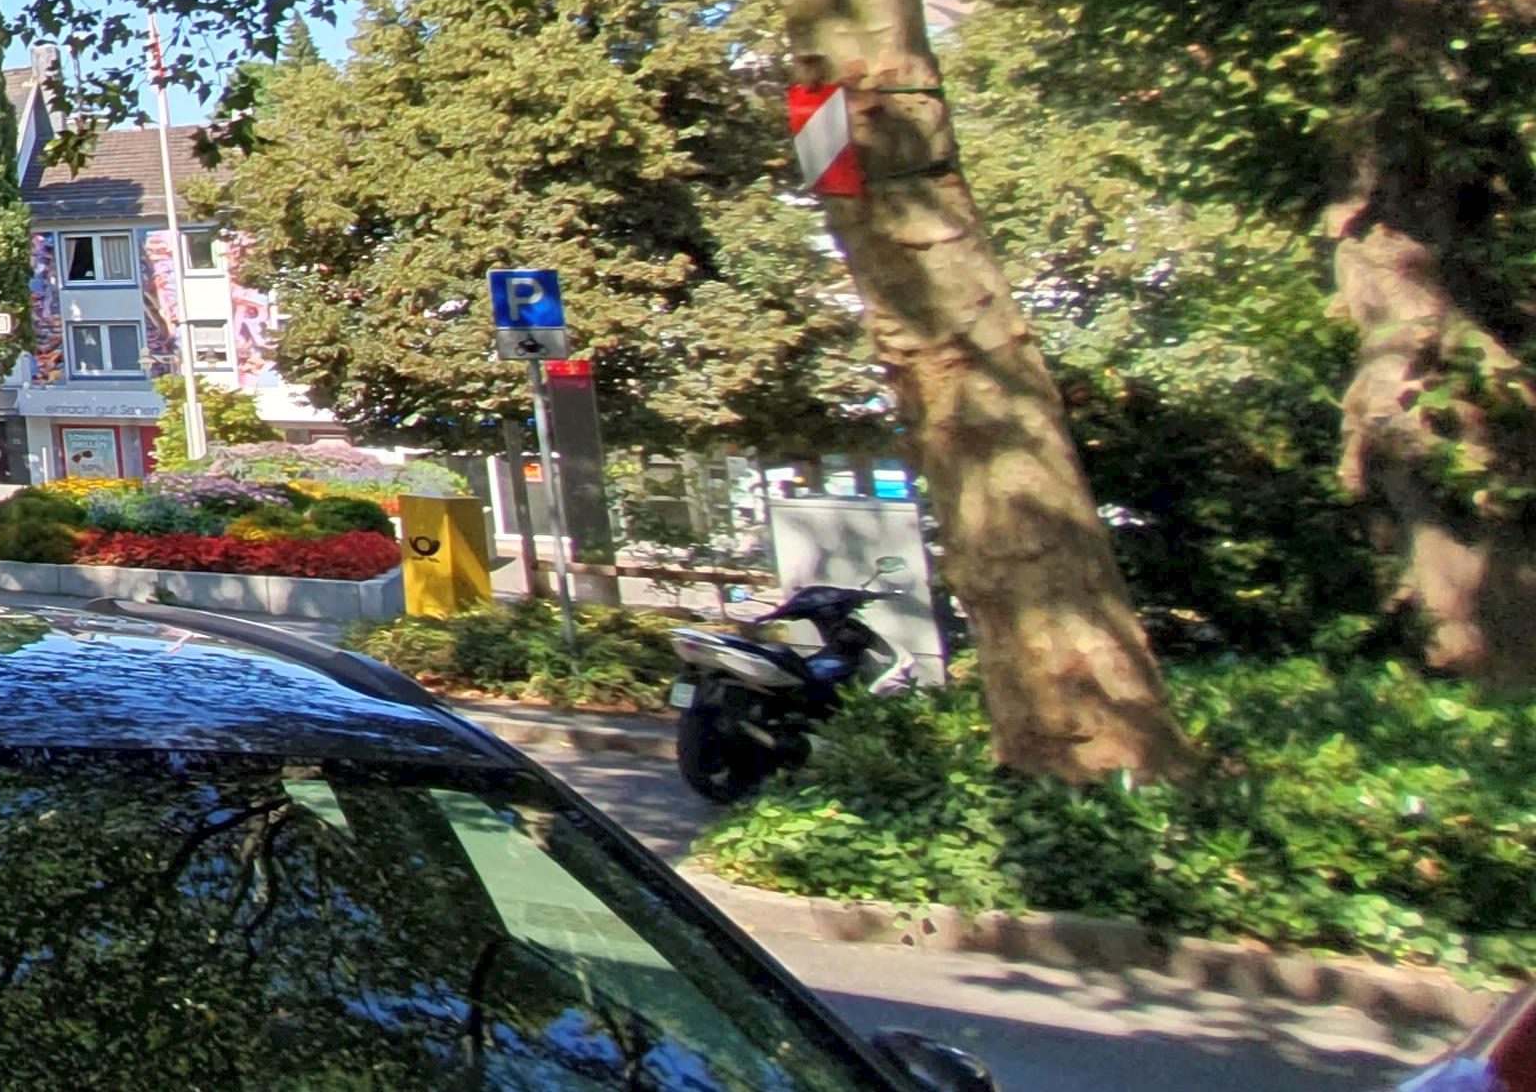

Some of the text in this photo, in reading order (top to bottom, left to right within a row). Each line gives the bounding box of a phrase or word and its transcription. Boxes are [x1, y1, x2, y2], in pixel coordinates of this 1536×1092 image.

[506, 277, 544, 321] P
[45, 404, 91, 414] einfach
[96, 404, 116, 416] gut
